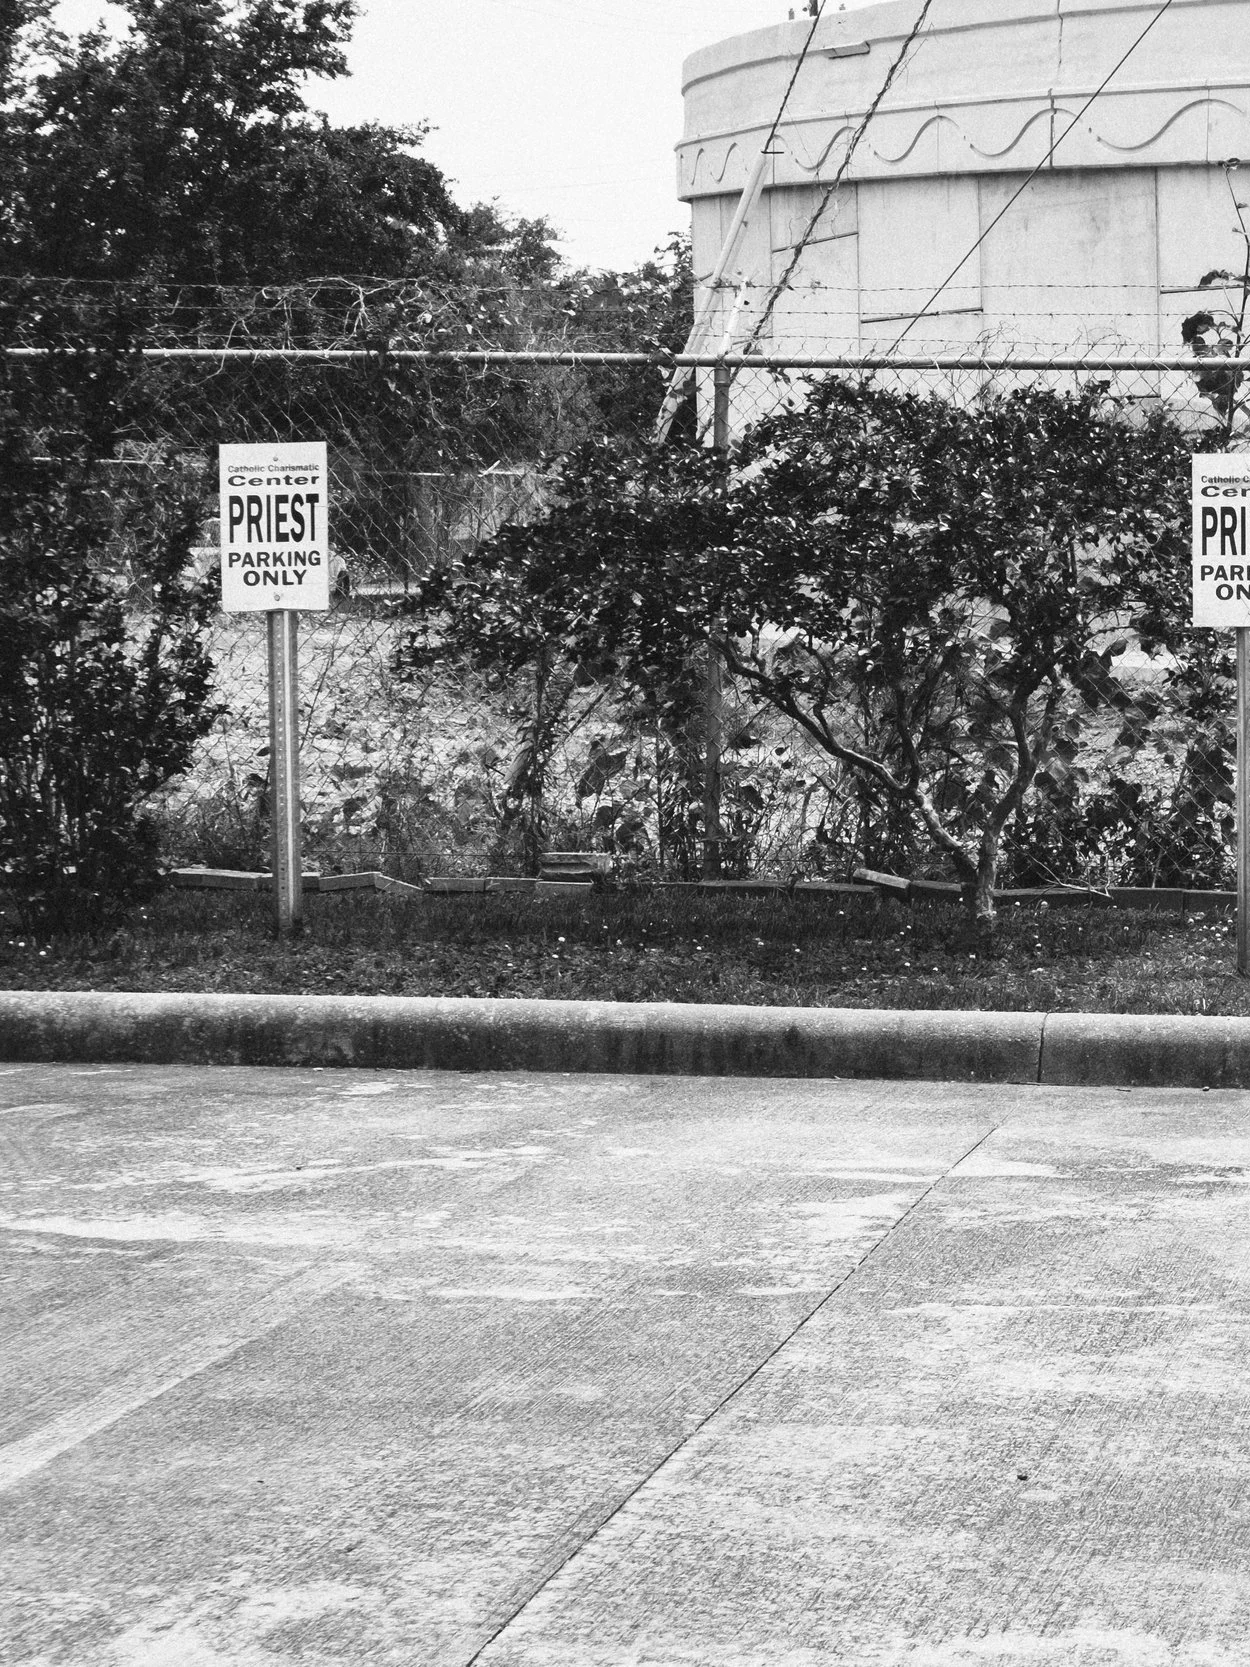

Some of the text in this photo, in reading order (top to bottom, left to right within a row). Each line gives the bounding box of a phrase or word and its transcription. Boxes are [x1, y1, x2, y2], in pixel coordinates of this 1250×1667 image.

[228, 463, 320, 473] Catholic Charismatic
[228, 475, 320, 486] Center
[1201, 475, 1240, 484] Catholic
[229, 493, 319, 543] PRIEST
[228, 550, 321, 568] PARKING
[243, 569, 307, 587] ONLY
